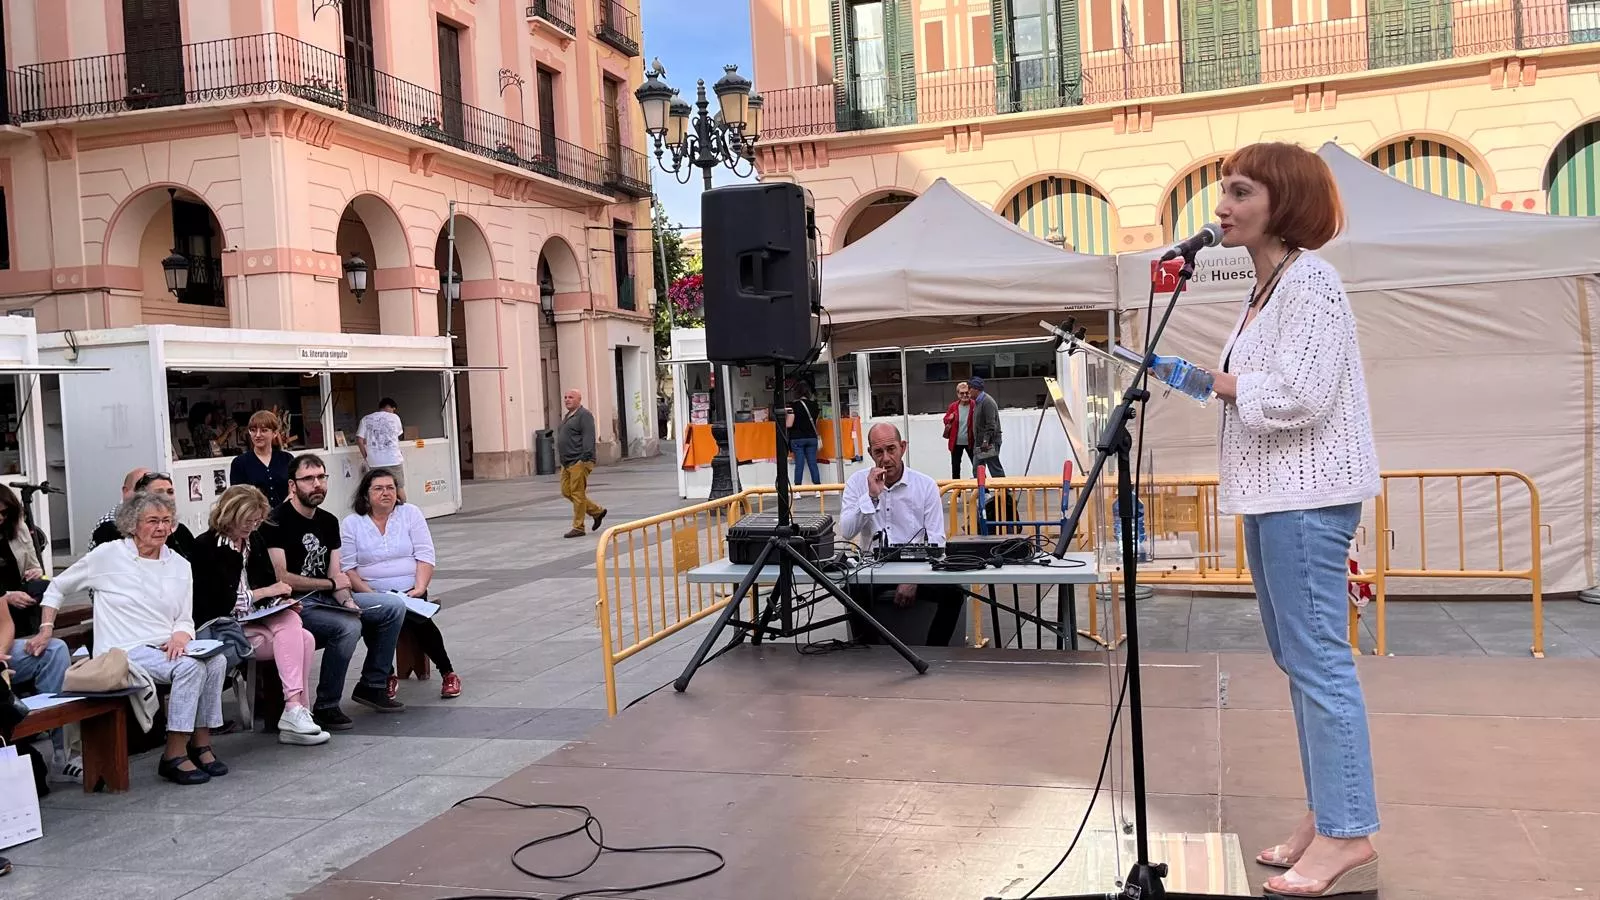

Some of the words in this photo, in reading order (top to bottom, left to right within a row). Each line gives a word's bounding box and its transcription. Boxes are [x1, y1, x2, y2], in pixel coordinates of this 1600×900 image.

[1195, 256, 1252, 270] Ayuntam
[1191, 272, 1207, 283] de
[1211, 269, 1256, 281] Huesc
